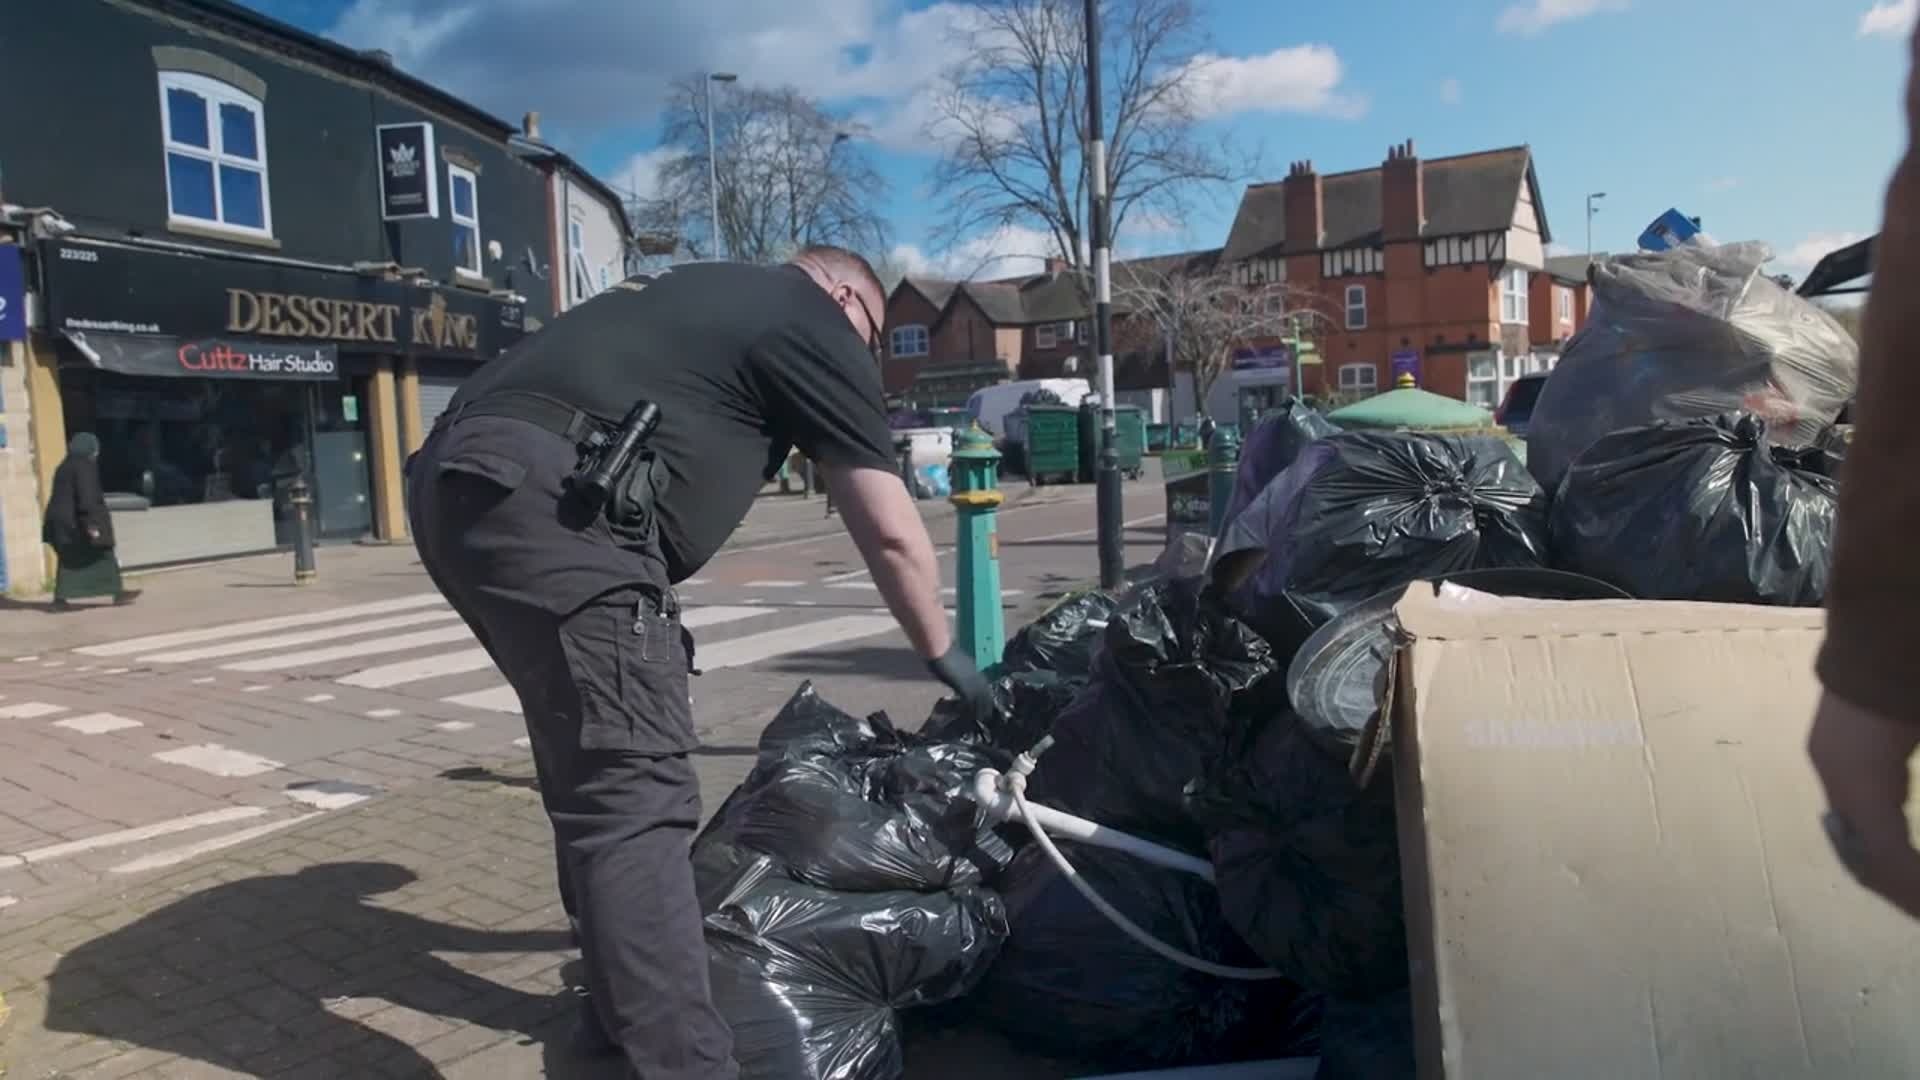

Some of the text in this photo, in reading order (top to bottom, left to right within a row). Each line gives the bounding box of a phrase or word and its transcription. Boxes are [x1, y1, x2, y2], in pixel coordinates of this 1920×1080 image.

[225, 287, 400, 342] DESSERT
[178, 343, 334, 373] Cuttz Hair Studio
